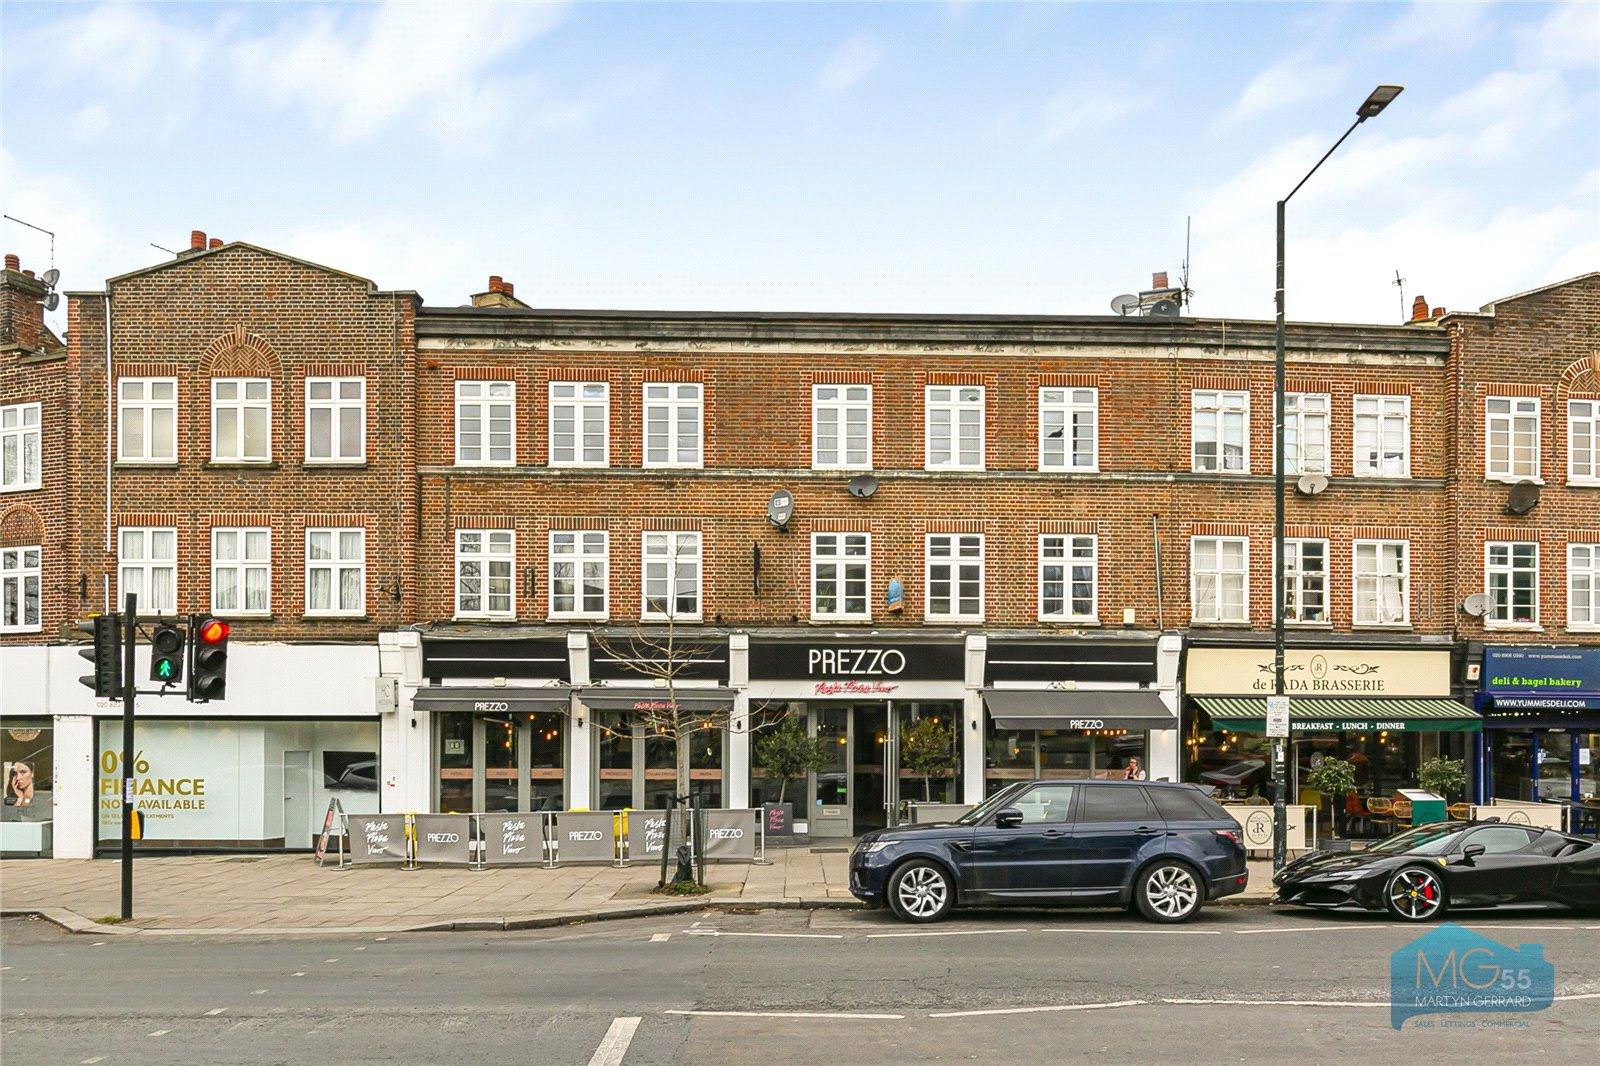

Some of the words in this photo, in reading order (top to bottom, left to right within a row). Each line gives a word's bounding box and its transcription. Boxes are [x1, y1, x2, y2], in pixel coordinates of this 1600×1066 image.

[809, 649, 906, 674] PREZZO
[1252, 678, 1267, 690] de
[1312, 679, 1385, 691] BRASSERIE
[1492, 676, 1510, 685] deli
[1512, 677, 1520, 685] &
[1521, 677, 1547, 687] bagel
[1549, 678, 1582, 688] bakery
[474, 702, 508, 712] PREZZO
[1496, 699, 1586, 708] WWW.YUMMIESDELI.COM
[1070, 719, 1104, 729] PREZZO
[1291, 722, 1334, 730] BREAKFAST
[1342, 722, 1368, 730] LUNCH
[1376, 722, 1405, 730] DINNER
[101, 749, 150, 774] 0%
[101, 799, 123, 810] NO
[137, 799, 205, 810] AVAILABLE
[364, 821, 390, 832] Pasta
[502, 820, 526, 832] Pasta
[644, 818, 667, 829] Pasta
[366, 832, 390, 843] Pizza
[427, 833, 459, 843] PREZZO
[502, 831, 526, 843] Pizza
[569, 830, 603, 841] PREZZO
[709, 828, 744, 839] PREZZO
[367, 844, 389, 855] Vino
[502, 844, 526, 855] Vino
[645, 840, 664, 853] Vino
